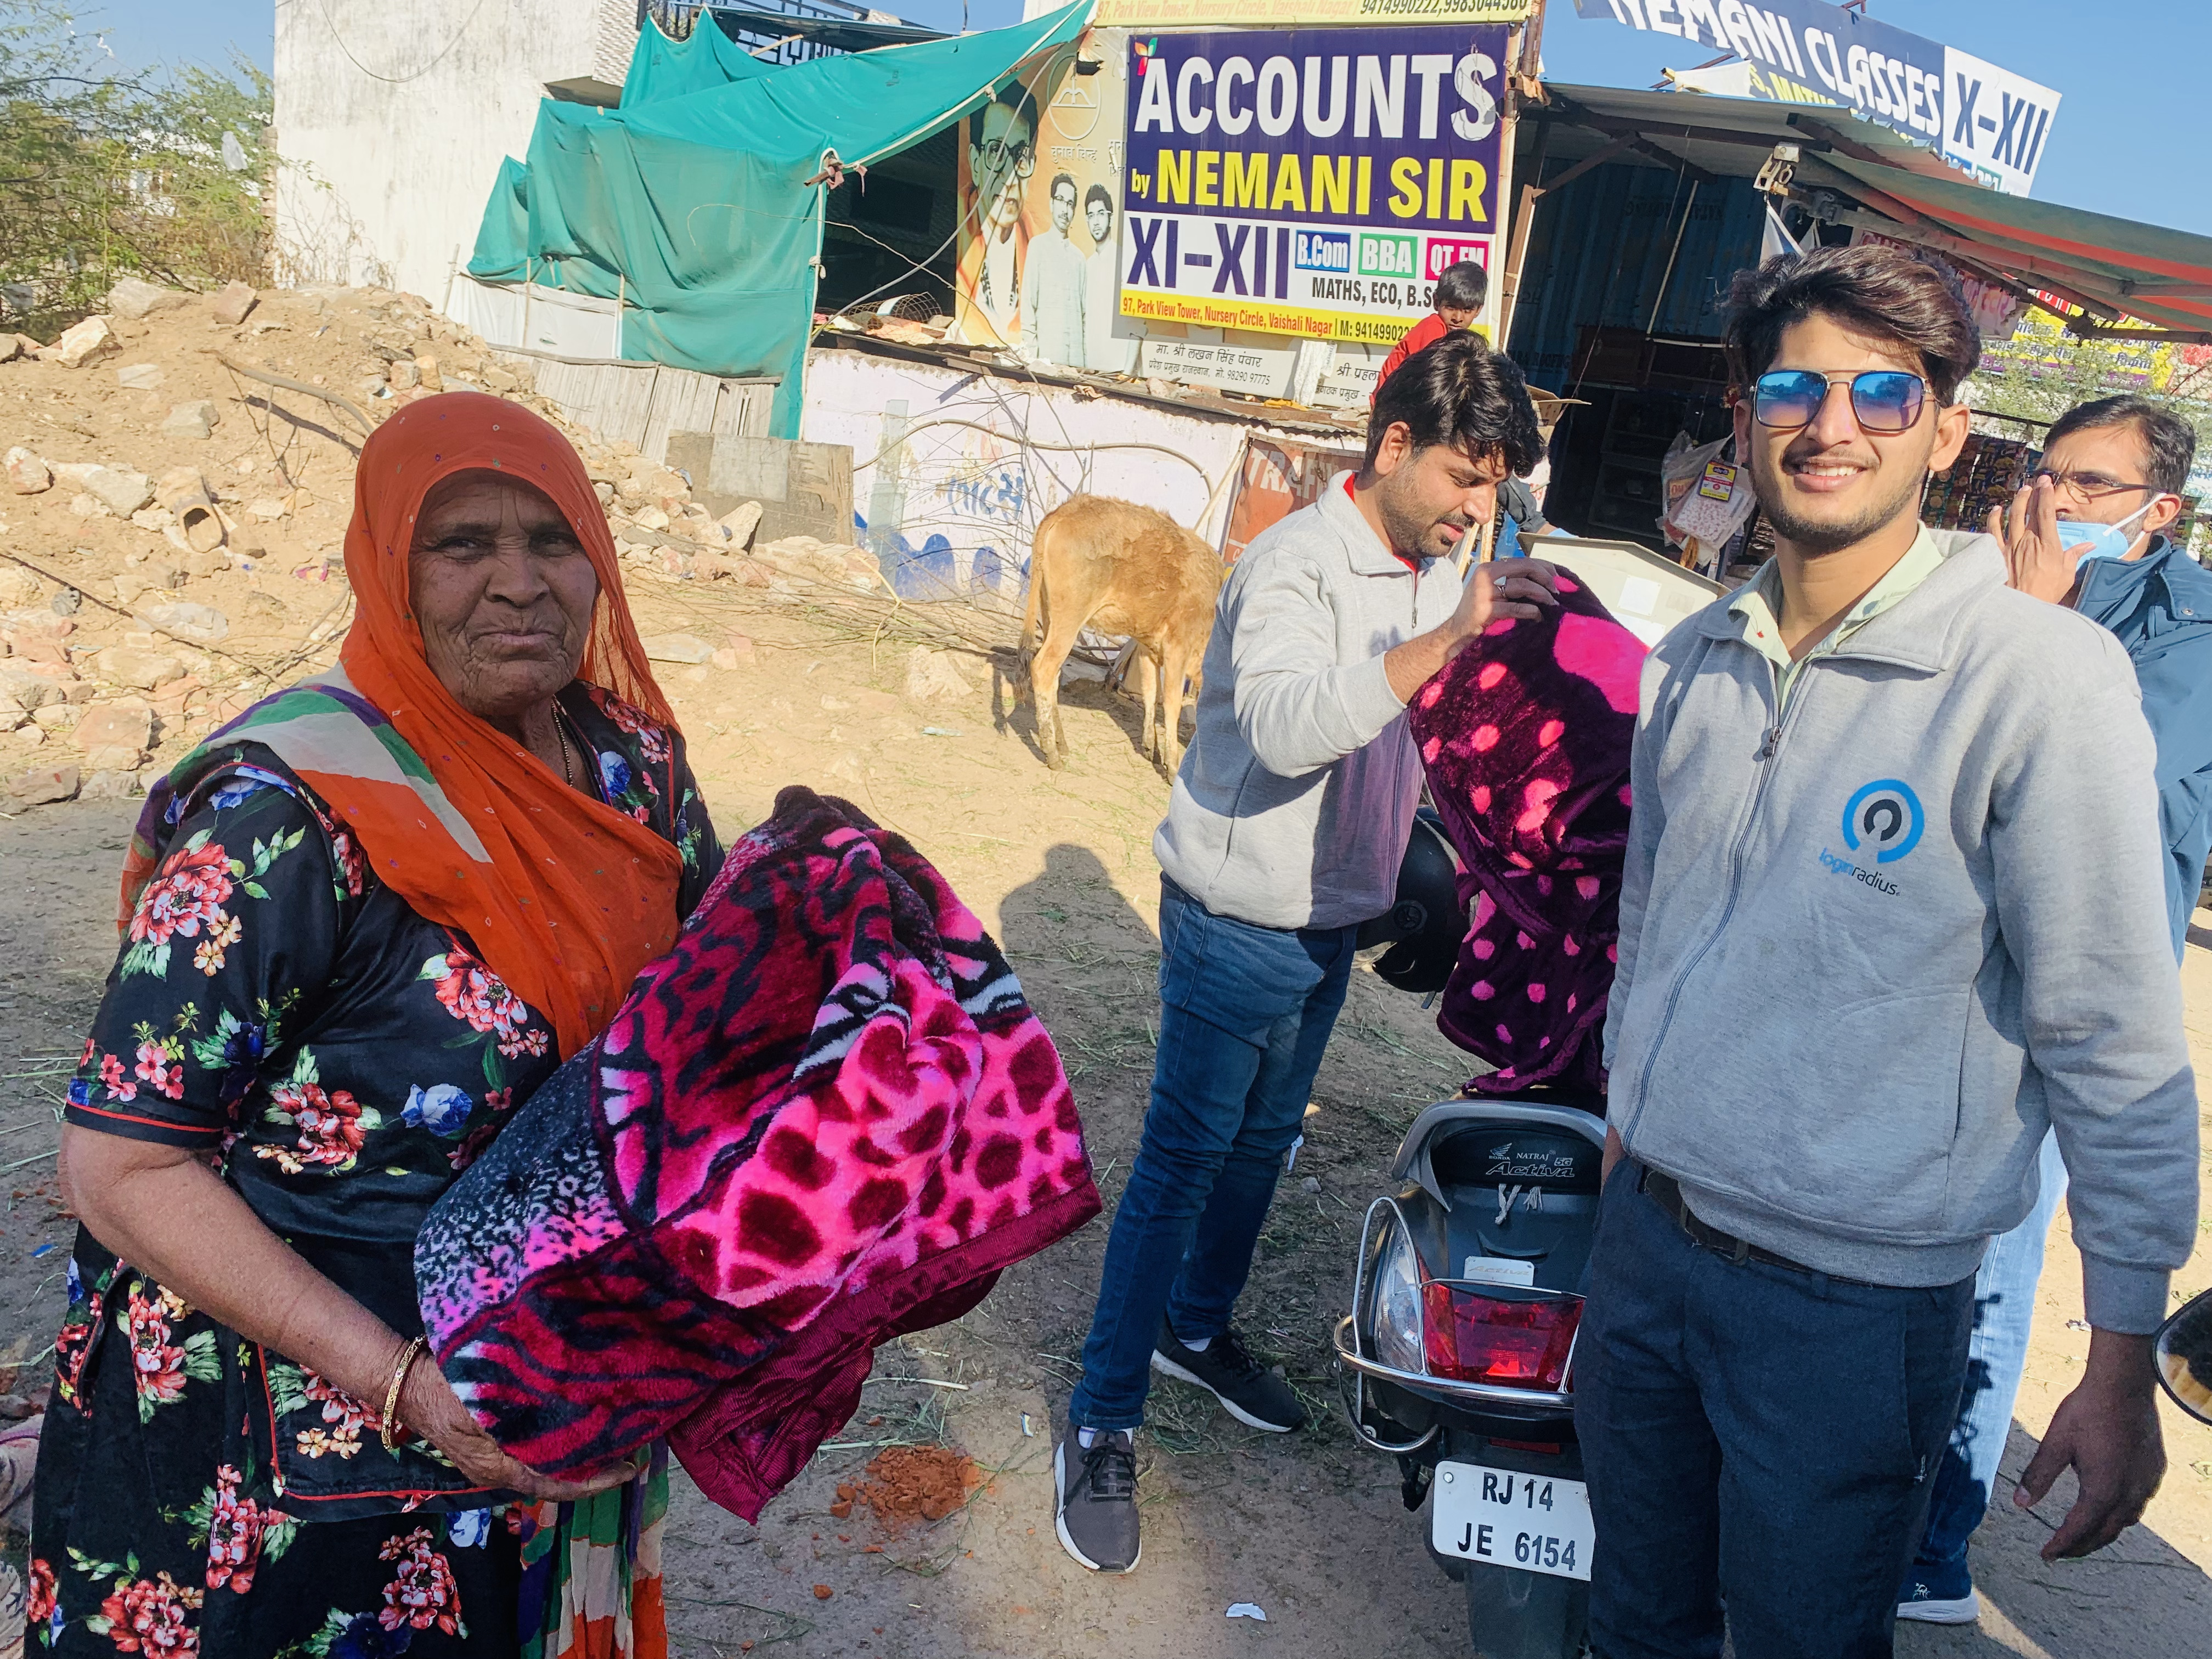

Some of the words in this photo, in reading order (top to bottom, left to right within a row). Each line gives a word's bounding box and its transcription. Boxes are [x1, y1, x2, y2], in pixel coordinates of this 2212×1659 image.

[1114, 1, 1135, 18] Park
[1137, 0, 1159, 18] View
[1317, 0, 1353, 19] Nagar
[1134, 53, 1500, 142] ACCOUNTS
[1804, 27, 1940, 136] CLASSES
[1953, 72, 2049, 175] X-XII
[1131, 168, 1150, 199] by
[1157, 150, 1372, 215] NEMANI
[1389, 156, 1488, 222] SIR
[1297, 234, 1349, 269] B.Com
[1362, 239, 1412, 273] BBA
[1312, 277, 1366, 306] MATHS,
[1371, 281, 1402, 309] ECO,
[1407, 285, 1432, 308] B.S
[1123, 297, 1135, 315] 97,
[1137, 299, 1154, 315] Park
[1156, 301, 1175, 317] View
[1177, 303, 1203, 322] Tower,
[1204, 306, 1238, 328] Nursery
[1239, 309, 1267, 330] Circle,
[1269, 313, 1304, 331] Vaishali
[1305, 317, 1333, 337] Nagar
[1340, 320, 1353, 336] M:
[1149, 358, 1163, 370] प्रदेश
[1164, 362, 1181, 375] प्रमुख
[1227, 370, 1248, 382] 98290
[1250, 373, 1271, 385] 97775
[1173, 343, 1186, 357] श्री
[1188, 348, 1214, 360] लखन
[1216, 348, 1235, 364] सिंह
[1238, 351, 1263, 368] पंवार
[1336, 362, 1352, 376] श्री
[1339, 388, 1360, 402] प्रमुख
[1486, 1161, 1575, 1177] Activa
[1516, 1153, 1549, 1161] NATRAJ
[1555, 1158, 1573, 1166] 5G
[1482, 1472, 1514, 1505] RJ
[1524, 1479, 1553, 1512] 14
[1457, 1522, 1493, 1556] JE
[1515, 1532, 1576, 1571] 6154
